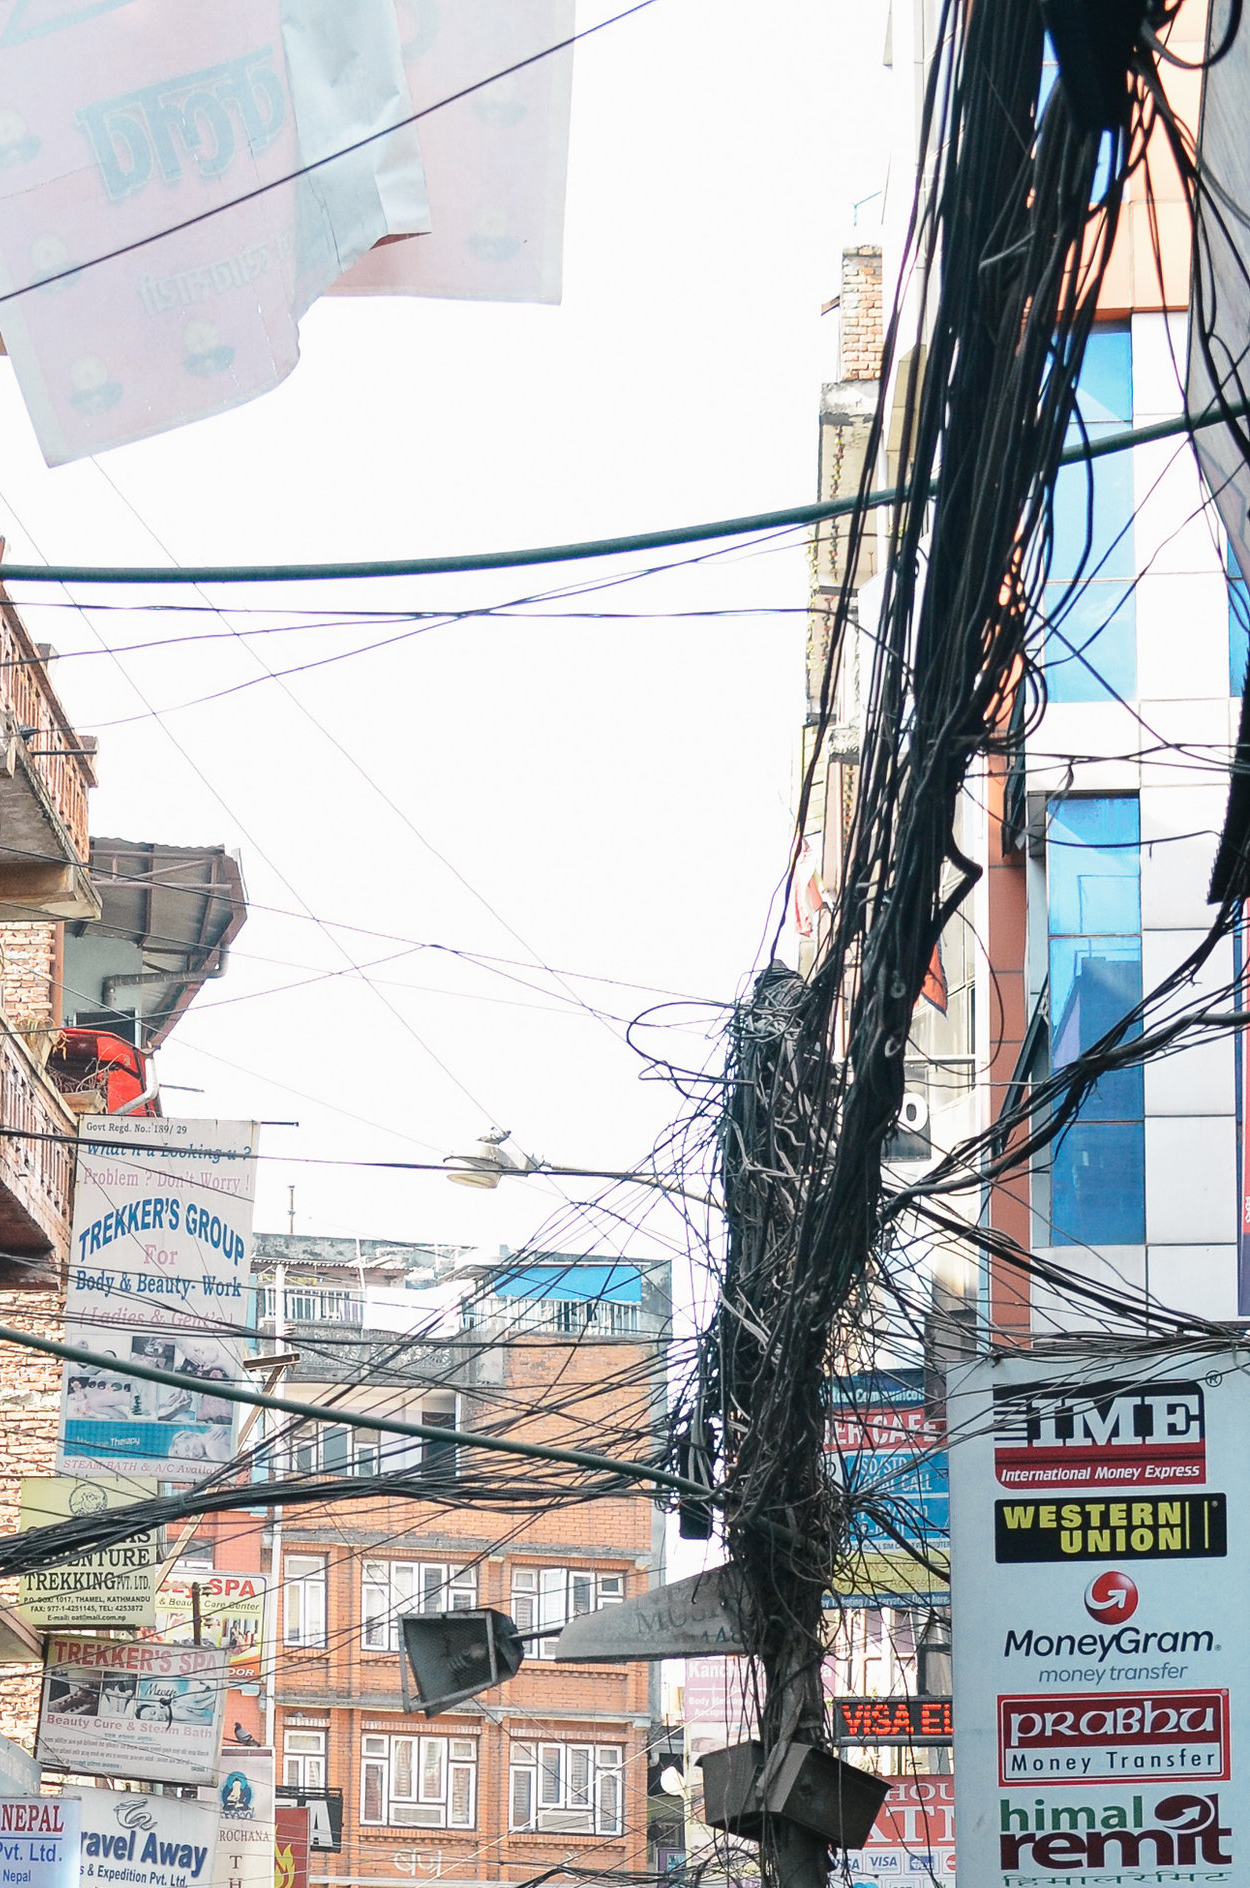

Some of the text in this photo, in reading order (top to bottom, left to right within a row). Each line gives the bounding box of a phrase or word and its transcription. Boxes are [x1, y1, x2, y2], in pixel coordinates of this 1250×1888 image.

[86, 1122, 106, 1132] Govt
[83, 1167, 241, 1193] Problem Worry
[78, 1197, 246, 1267] TREKKER'S GROUP
[143, 1243, 179, 1266] For
[75, 1269, 242, 1298] Body Work
[1030, 1394, 1201, 1448] IME
[1000, 1464, 1201, 1483] International Money Express
[1003, 1501, 1182, 1530] WESTERN
[1060, 1527, 1182, 1554] UNION
[24, 1571, 117, 1592] TREKKING
[207, 1578, 256, 1598] SPA
[1003, 1626, 1215, 1663] MoneyGram
[53, 1640, 219, 1677] TREKKER'S SPA
[1038, 1661, 1188, 1686] money transfer
[46, 1714, 213, 1739] Beauty Steam Bath
[1011, 1748, 1216, 1775] Money Transfer
[0, 1803, 65, 1833] NEPAL
[1000, 1795, 1144, 1832] himal
[1000, 1793, 1233, 1871] remit
[29, 1842, 63, 1863] Ltd.
[140, 1832, 209, 1879] Away
[870, 1855, 898, 1868] VISA
[2, 1869, 32, 1885] Nepal
[96, 1864, 148, 1885] Expedition
